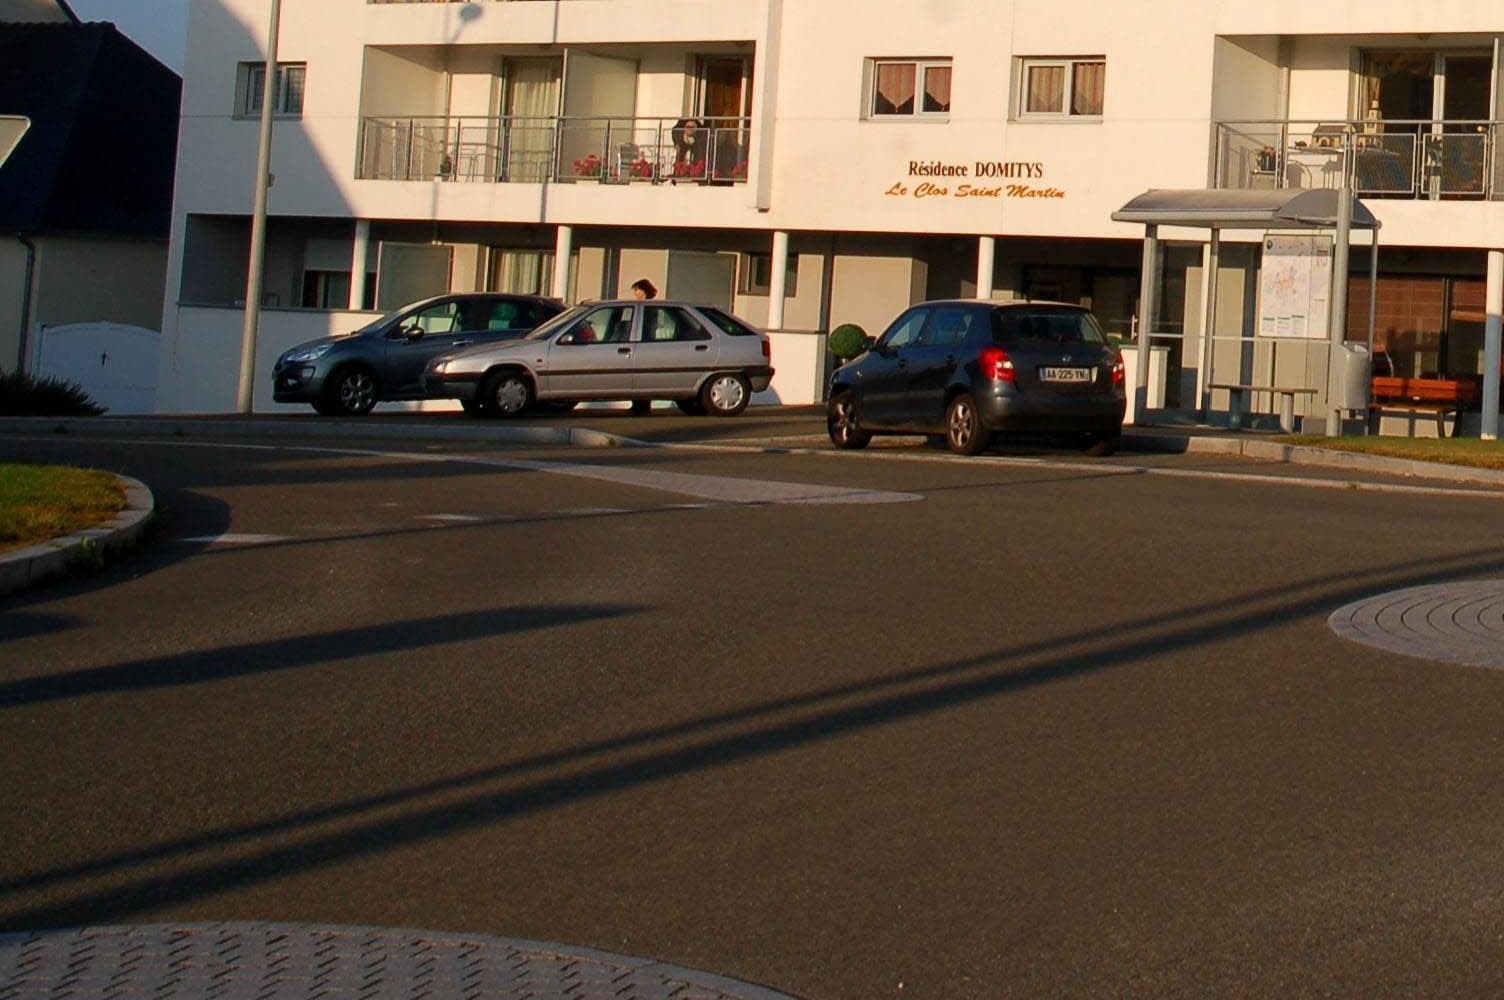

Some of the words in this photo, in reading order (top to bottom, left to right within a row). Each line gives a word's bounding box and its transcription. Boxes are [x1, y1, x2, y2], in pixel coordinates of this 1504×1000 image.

[909, 160, 968, 177] Résidence
[975, 162, 1043, 178] DOMITYS
[885, 182, 907, 196] Le
[914, 182, 948, 198] Clos
[955, 185, 1001, 198] Saint
[1006, 184, 1065, 199] Martin
